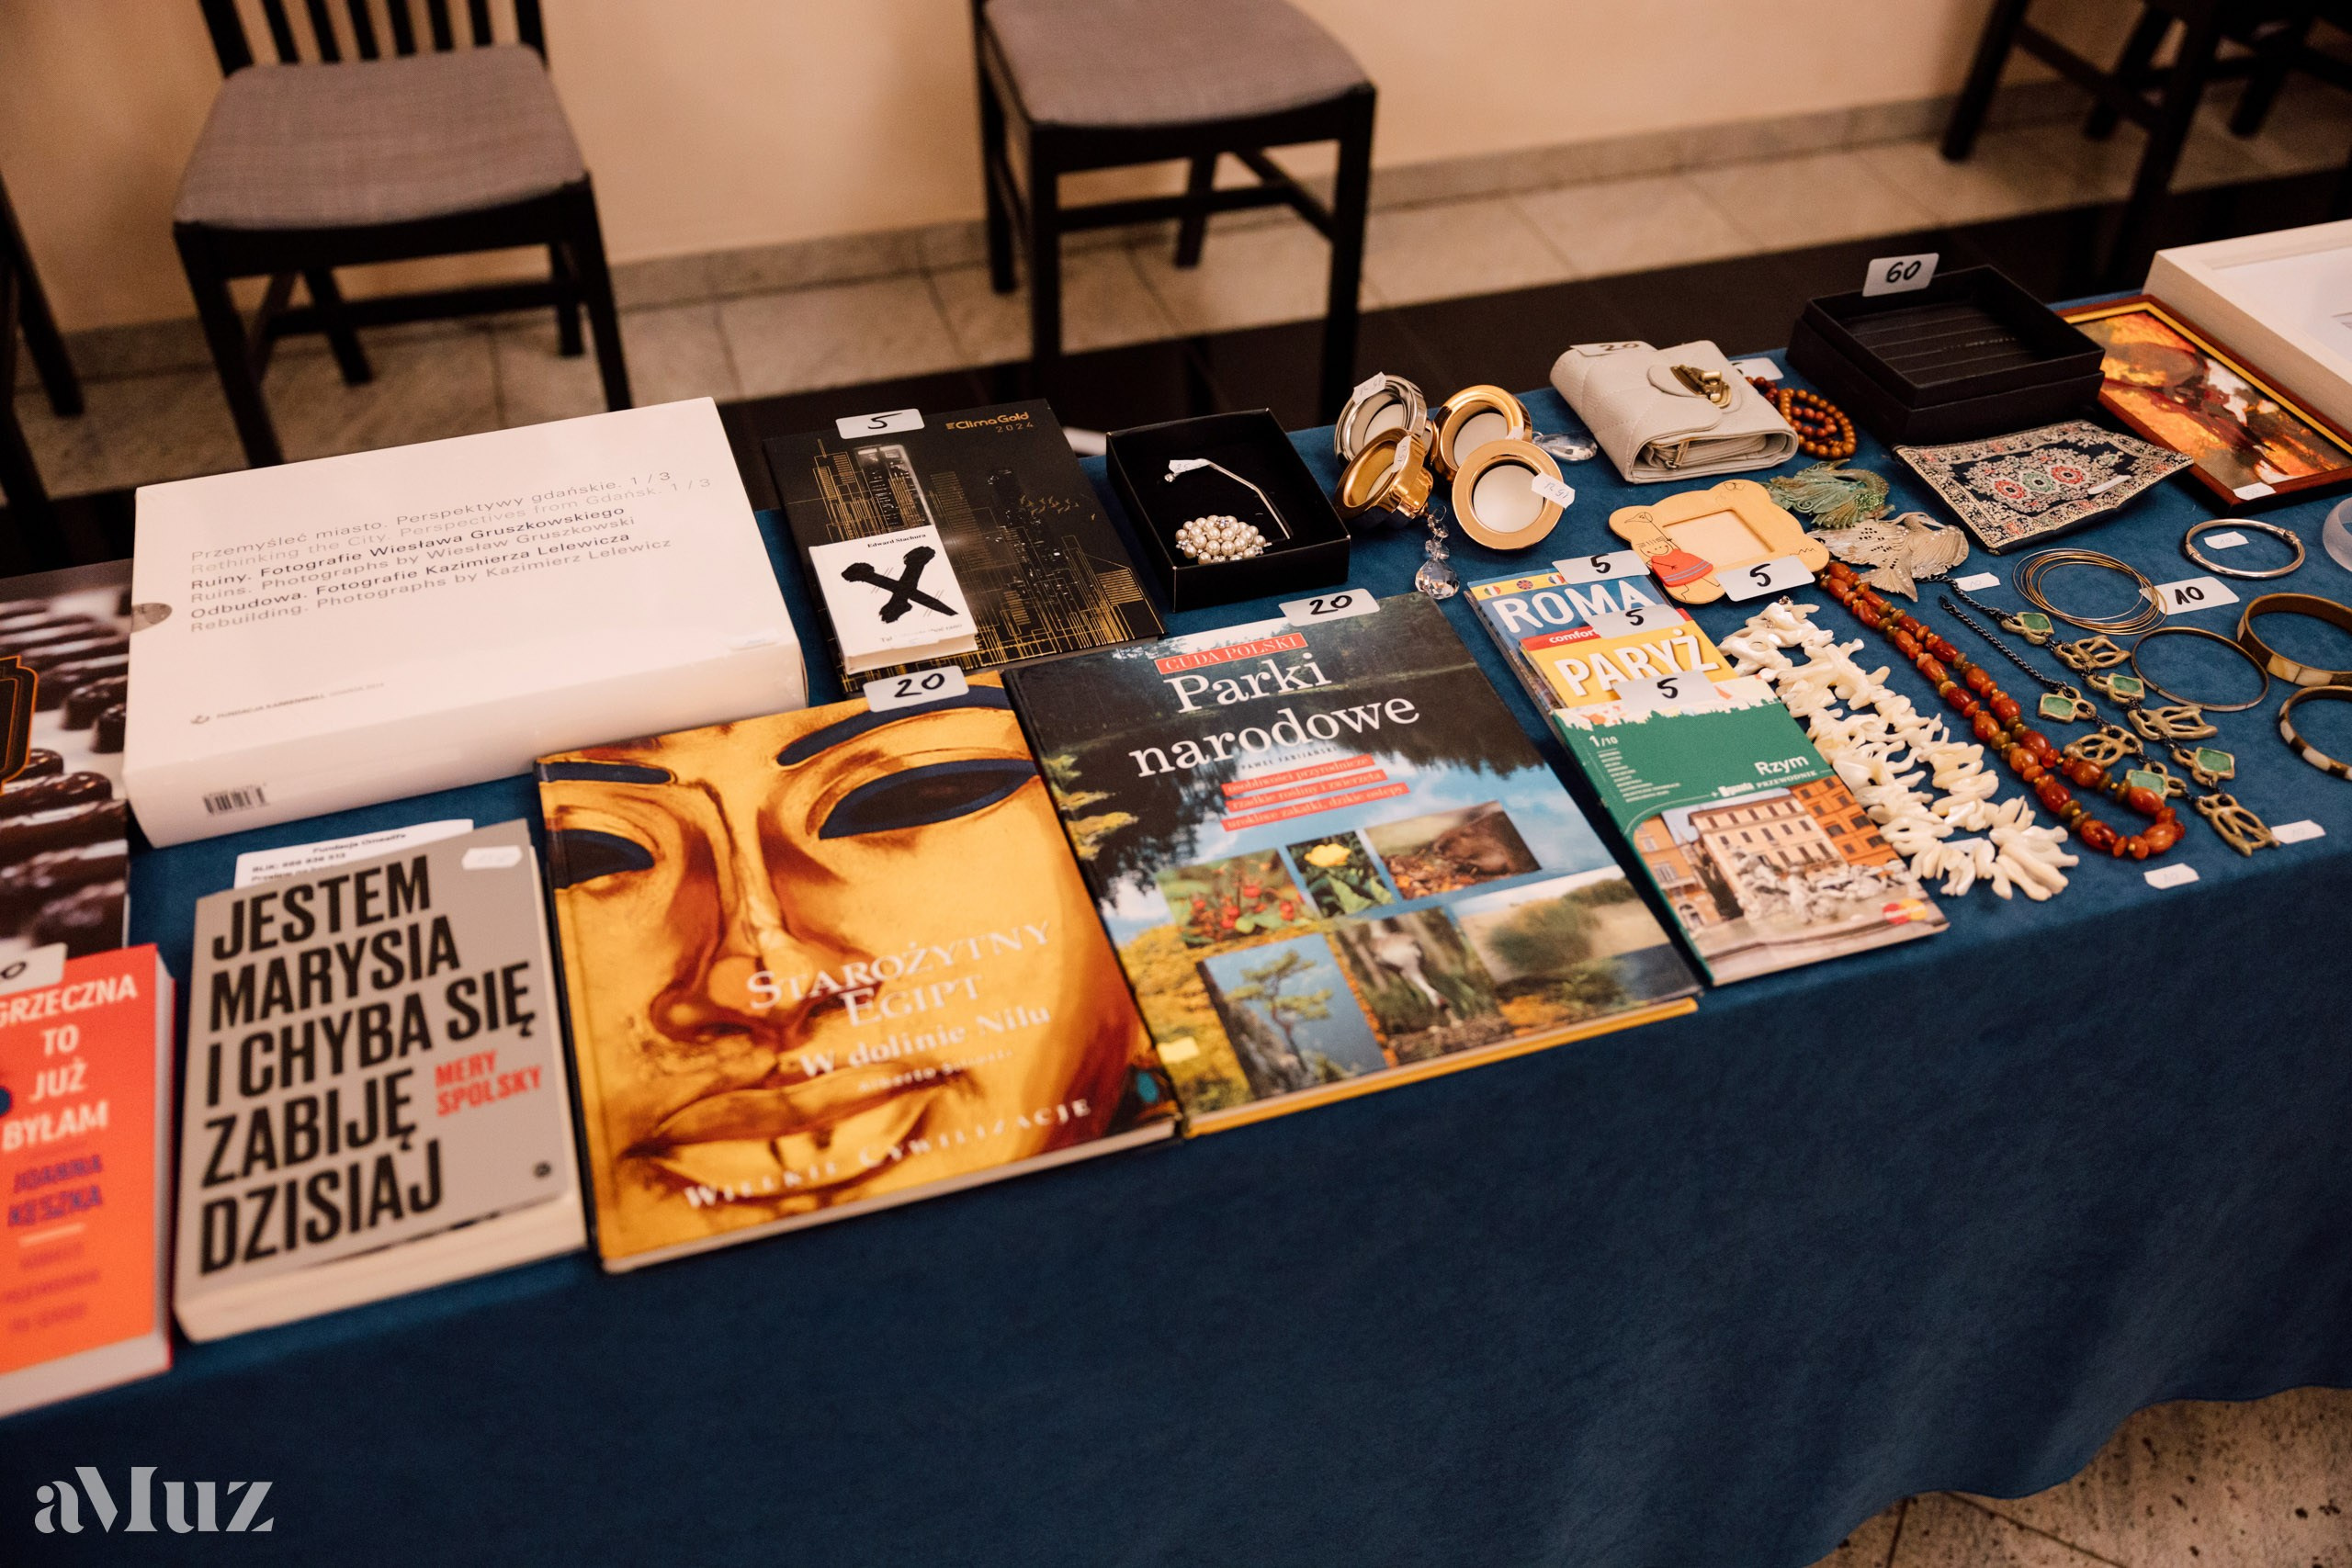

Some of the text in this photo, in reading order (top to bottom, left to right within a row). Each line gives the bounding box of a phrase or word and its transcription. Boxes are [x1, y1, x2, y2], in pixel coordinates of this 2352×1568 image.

[1886, 260, 1922, 284] 60
[1599, 342, 1640, 352] 20
[867, 412, 903, 430] 5
[996, 421, 1034, 434] 2024
[191, 533, 308, 562] Przemyśleć
[315, 521, 389, 540] miasto.
[396, 496, 525, 526] Perspektywy
[531, 480, 622, 505] gdańskie.
[659, 471, 672, 481] 3
[191, 548, 300, 575] Rethinking
[309, 539, 340, 555] the
[347, 532, 390, 547] City.
[400, 508, 527, 538] Perspectives
[534, 501, 579, 515] from
[585, 487, 662, 506] Gdańsk.
[699, 478, 711, 488] 3
[866, 531, 927, 548] Edward Stachura
[191, 506, 626, 591] Ruiny. Fotografie Wiesława Gruszkowskiego
[191, 516, 636, 604] Ruins. Photographs by Wiesław Gruszkowski
[1590, 554, 1611, 574] 5
[191, 532, 630, 620] Odbudowa. Fotografie Kazimierza Lelewicza
[191, 538, 673, 633] Rebuilding. Photographs by Kazimierz Lelewicz
[1749, 563, 1772, 588] 5
[2174, 586, 2206, 605] 10
[1309, 595, 1353, 615] 20
[1491, 580, 1663, 634] ROMA
[1625, 608, 1645, 626] 5
[1165, 636, 1298, 671] CUDA POLSKI
[1548, 630, 1600, 644] comfor
[1555, 627, 1720, 697] PARYŻ
[894, 672, 945, 698] 20
[1163, 652, 1332, 714] Parki
[1657, 677, 1678, 699] 5
[1127, 697, 1420, 778] narodowe
[1589, 735, 1619, 748] 1/10
[1754, 755, 1810, 777] Rzym
[212, 854, 431, 961] JESTEM
[209, 915, 462, 1032] MARYSIA
[746, 919, 1051, 1010] STAROŻYTNY
[839, 974, 983, 1028] EGIPT
[40, 1014, 80, 1057] TO
[206, 961, 537, 1108] I CHYBA SIĘ
[799, 1005, 1051, 1077] W dolinie Nilu
[29, 1056, 89, 1103] JUŻ
[435, 1048, 498, 1089] MERY
[436, 1065, 542, 1118] SPOLSKY
[2, 1100, 109, 1153] BYŁAM
[200, 1067, 417, 1190] ZABIJĘ
[199, 1139, 443, 1277] DZISIAJ
